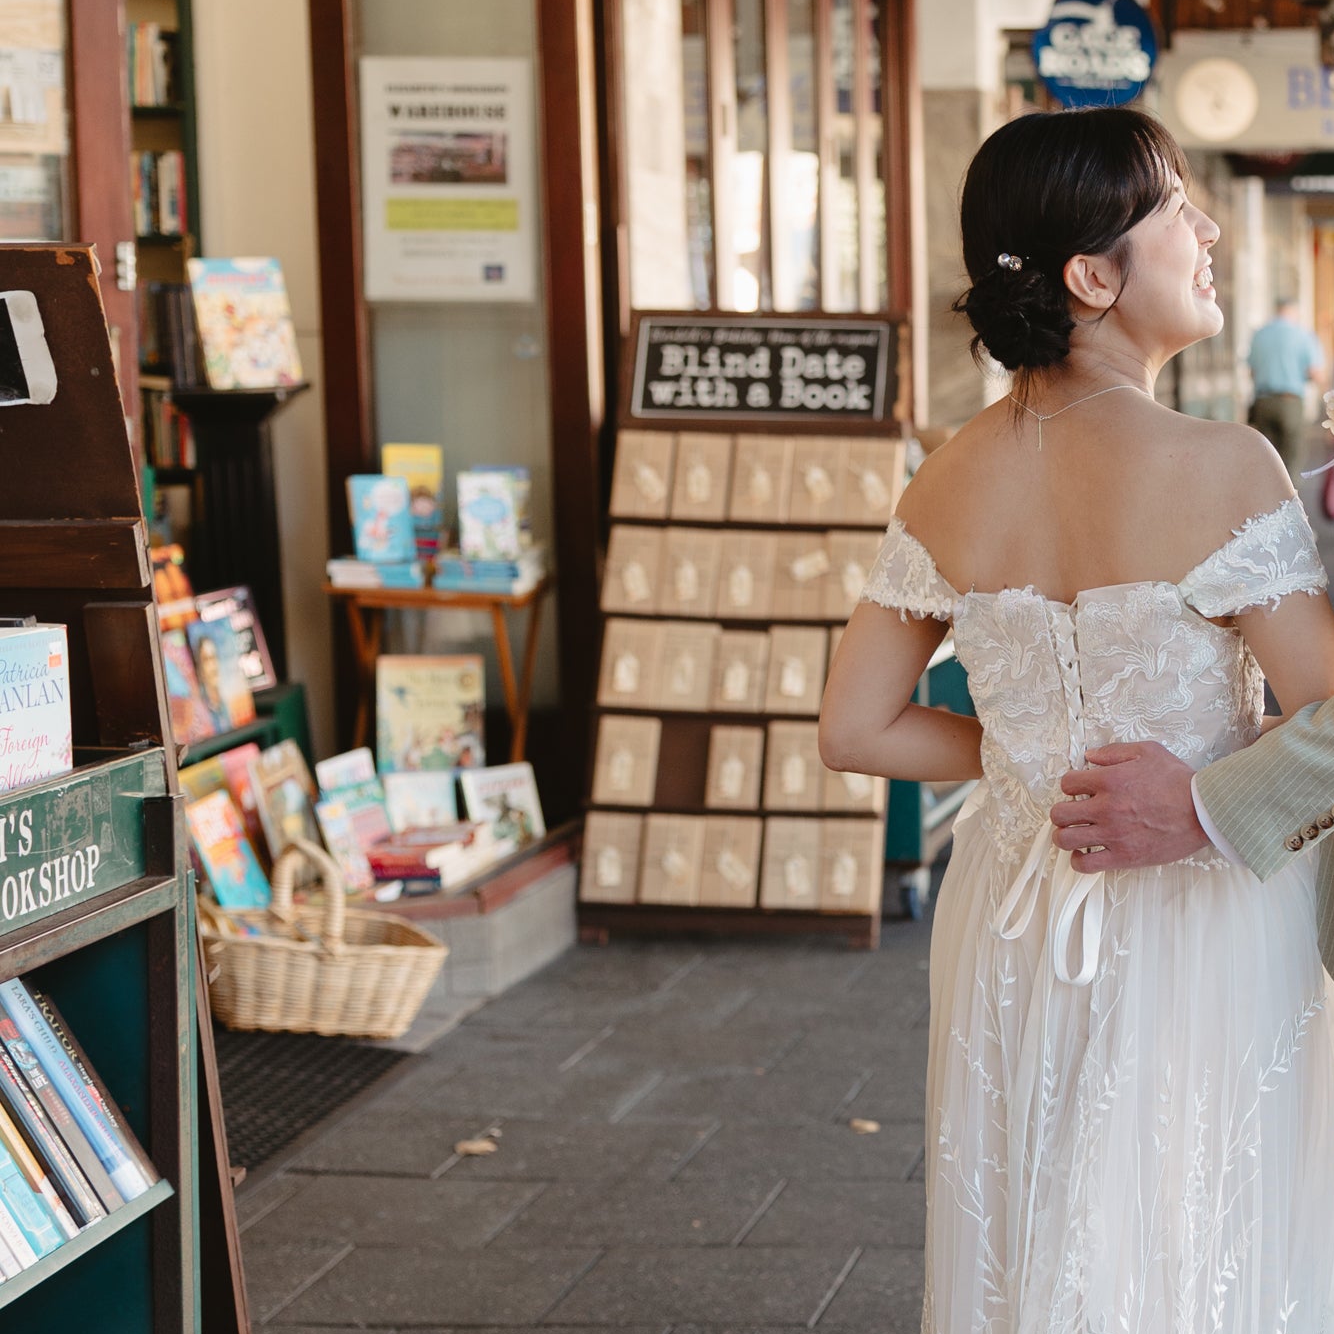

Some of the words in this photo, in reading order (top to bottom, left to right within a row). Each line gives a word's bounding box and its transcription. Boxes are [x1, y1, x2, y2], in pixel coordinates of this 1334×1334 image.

[659, 344, 771, 378] Blind
[779, 346, 866, 380] Date
[648, 376, 739, 407] with
[746, 382, 771, 408] a
[779, 378, 871, 410] Book
[0, 809, 33, 864] 'S
[2, 844, 100, 920] OKSHOP
[11, 986, 35, 1020] LARA'S
[34, 1020, 58, 1054] CHILD
[34, 990, 78, 1061] TRAITOR
